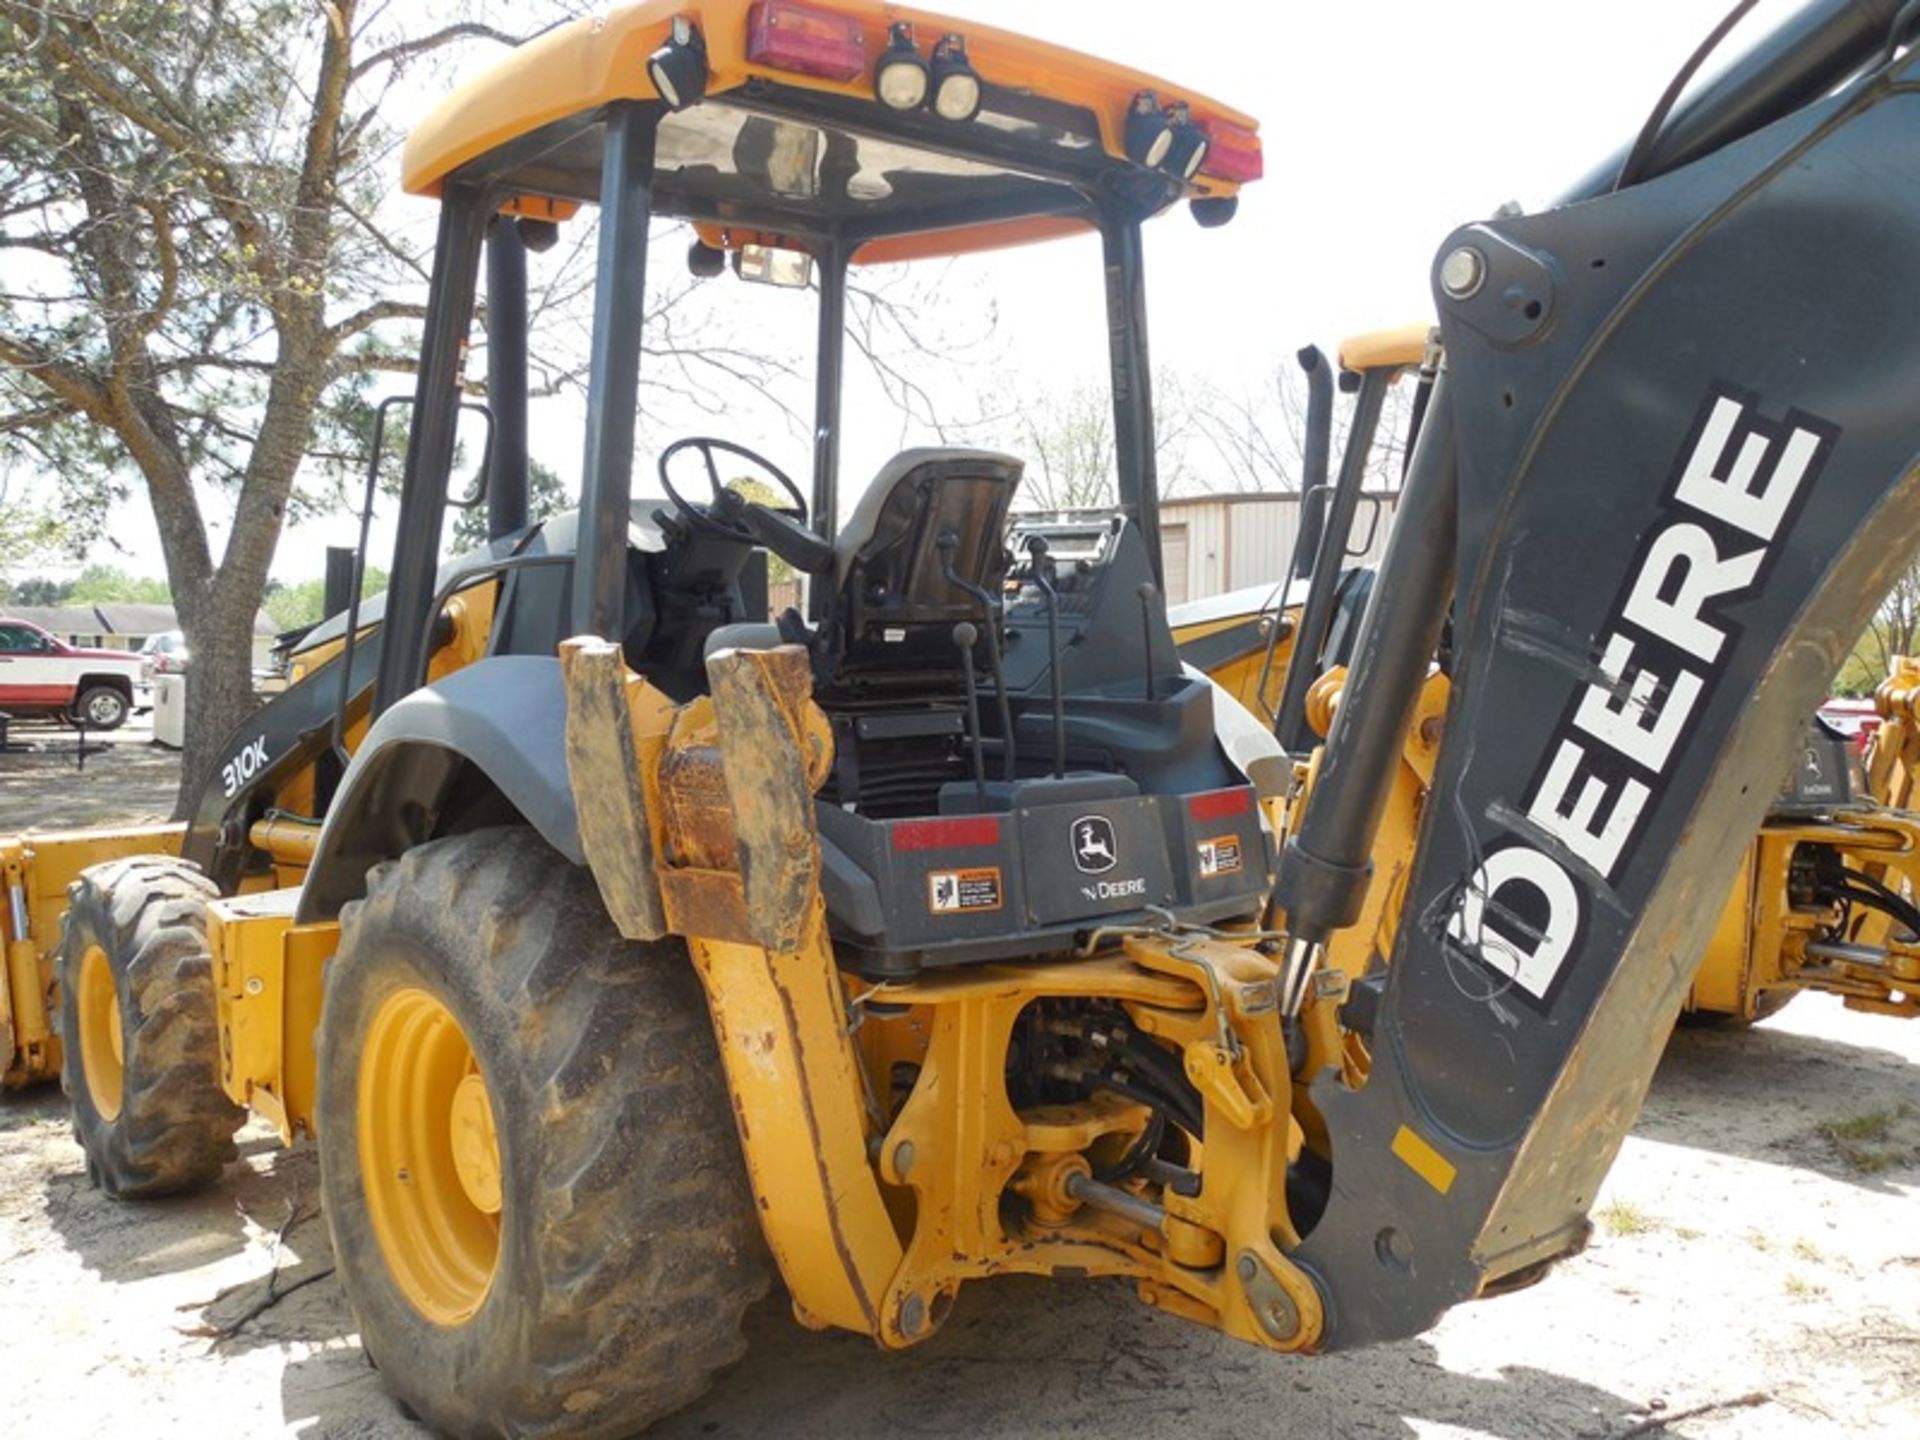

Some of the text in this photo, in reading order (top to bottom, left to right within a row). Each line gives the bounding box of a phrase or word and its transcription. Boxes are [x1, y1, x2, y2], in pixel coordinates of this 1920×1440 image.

[1447, 396, 1821, 999] DEERE
[222, 734, 269, 797] 310K
[1097, 878, 1146, 899] DEERE
